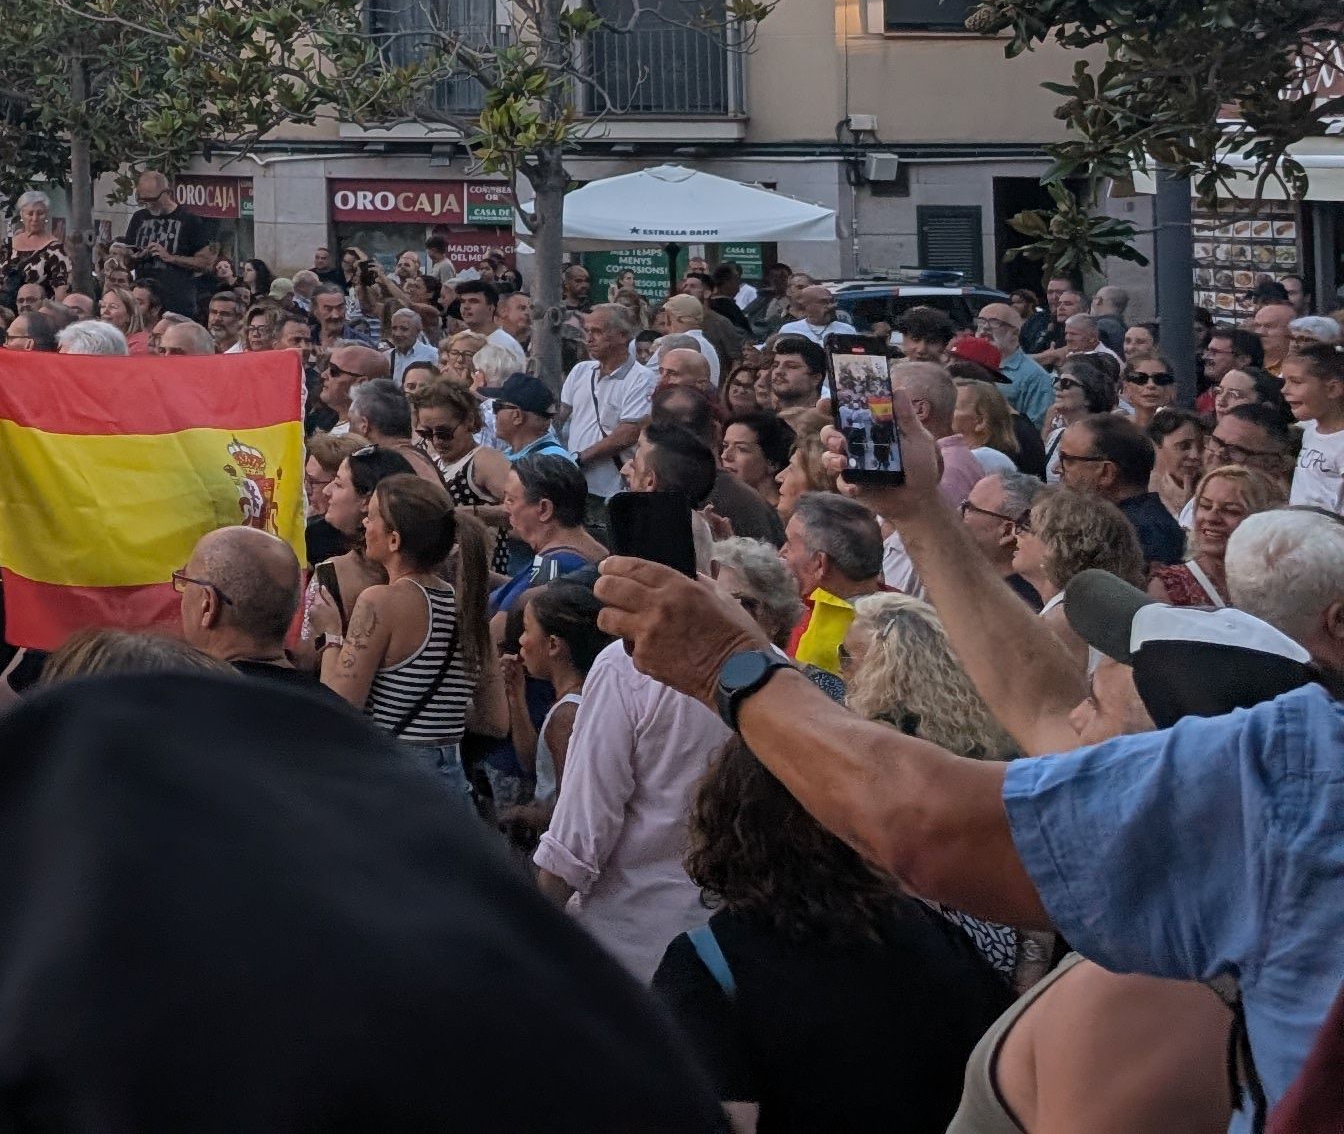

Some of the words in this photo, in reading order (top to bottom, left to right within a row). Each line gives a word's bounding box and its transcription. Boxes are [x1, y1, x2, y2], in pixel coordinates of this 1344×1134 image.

[176, 183, 236, 212] OROCAJA
[333, 190, 461, 216] OROCAJA
[473, 208, 497, 216] CASA
[447, 244, 479, 253] MAJOR
[450, 253, 467, 261] DEL
[618, 256, 652, 265] MENYS
